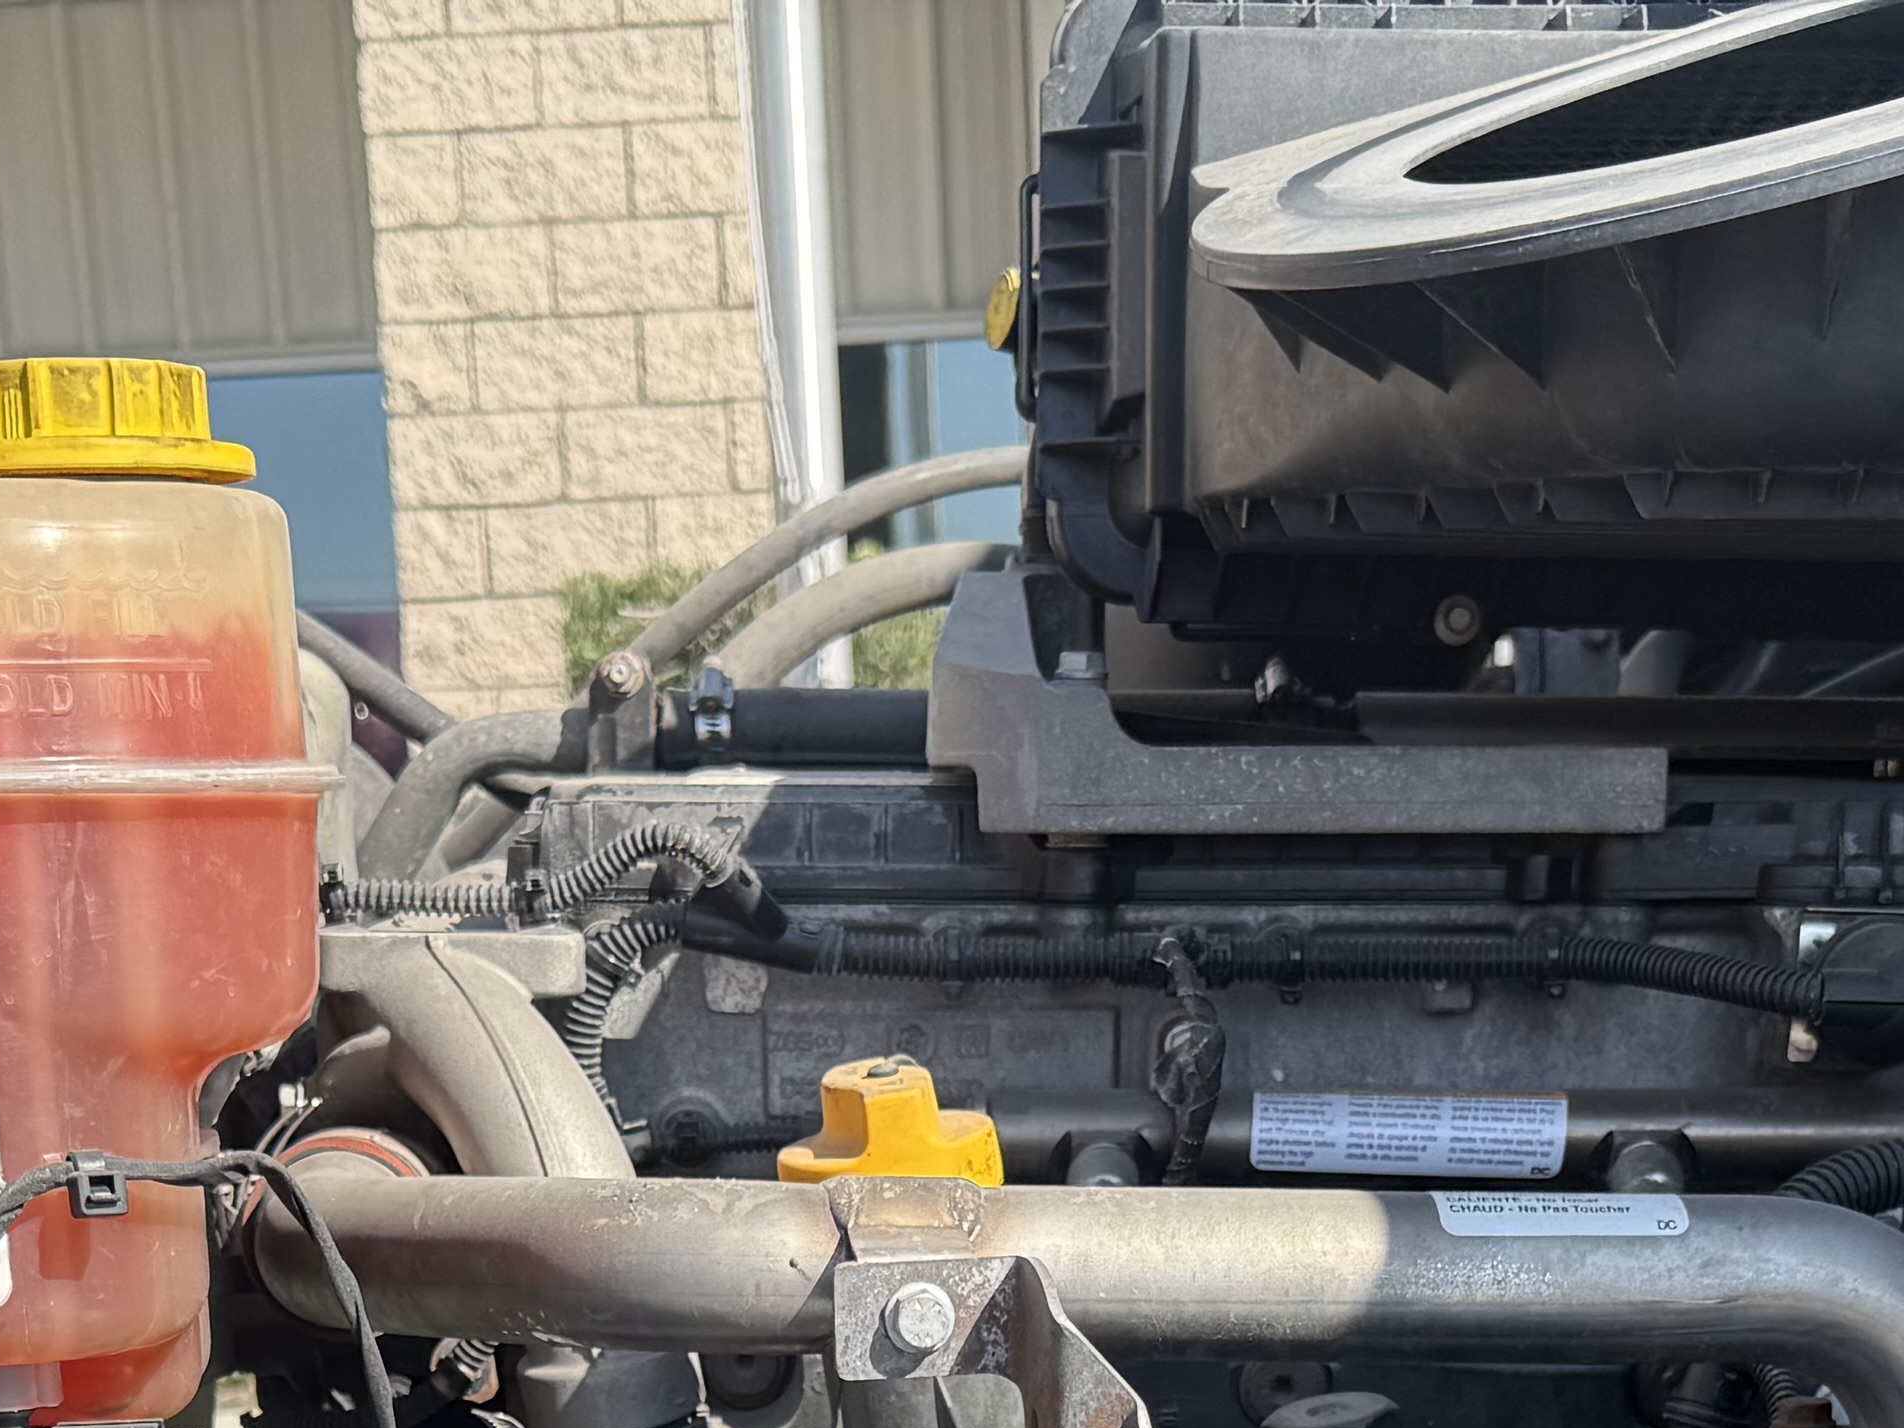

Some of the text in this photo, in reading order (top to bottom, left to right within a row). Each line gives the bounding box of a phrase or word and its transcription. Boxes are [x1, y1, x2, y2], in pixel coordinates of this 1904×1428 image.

[90, 596, 169, 638] FILL
[1531, 1167, 1552, 1176] DC
[1450, 1204, 1504, 1214] CHAUD
[1542, 1205, 1569, 1214] Pas
[1571, 1204, 1632, 1214] Toucher
[1657, 1220, 1678, 1231] DC
